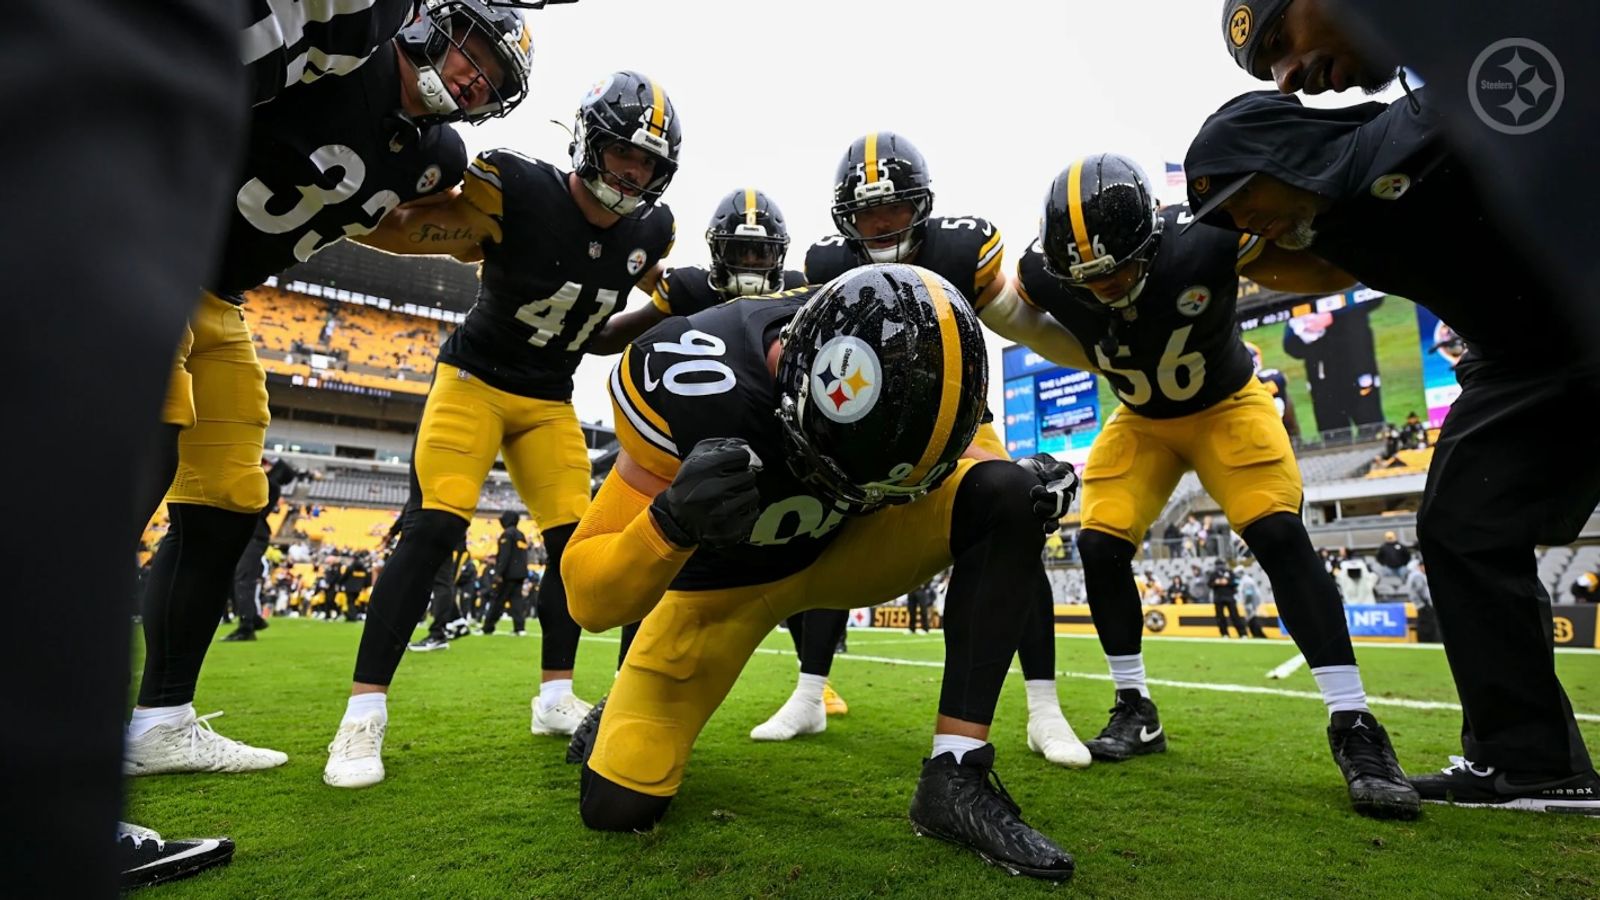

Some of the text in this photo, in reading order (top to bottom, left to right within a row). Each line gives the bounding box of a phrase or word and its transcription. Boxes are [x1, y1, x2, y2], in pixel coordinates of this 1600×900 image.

[408, 224, 476, 243] Faith
[1067, 234, 1106, 265] 56
[514, 281, 619, 351] 41
[652, 329, 737, 396] 90
[840, 347, 853, 377] Steelers
[1094, 324, 1206, 406] 56
[1353, 611, 1397, 627] NFL
